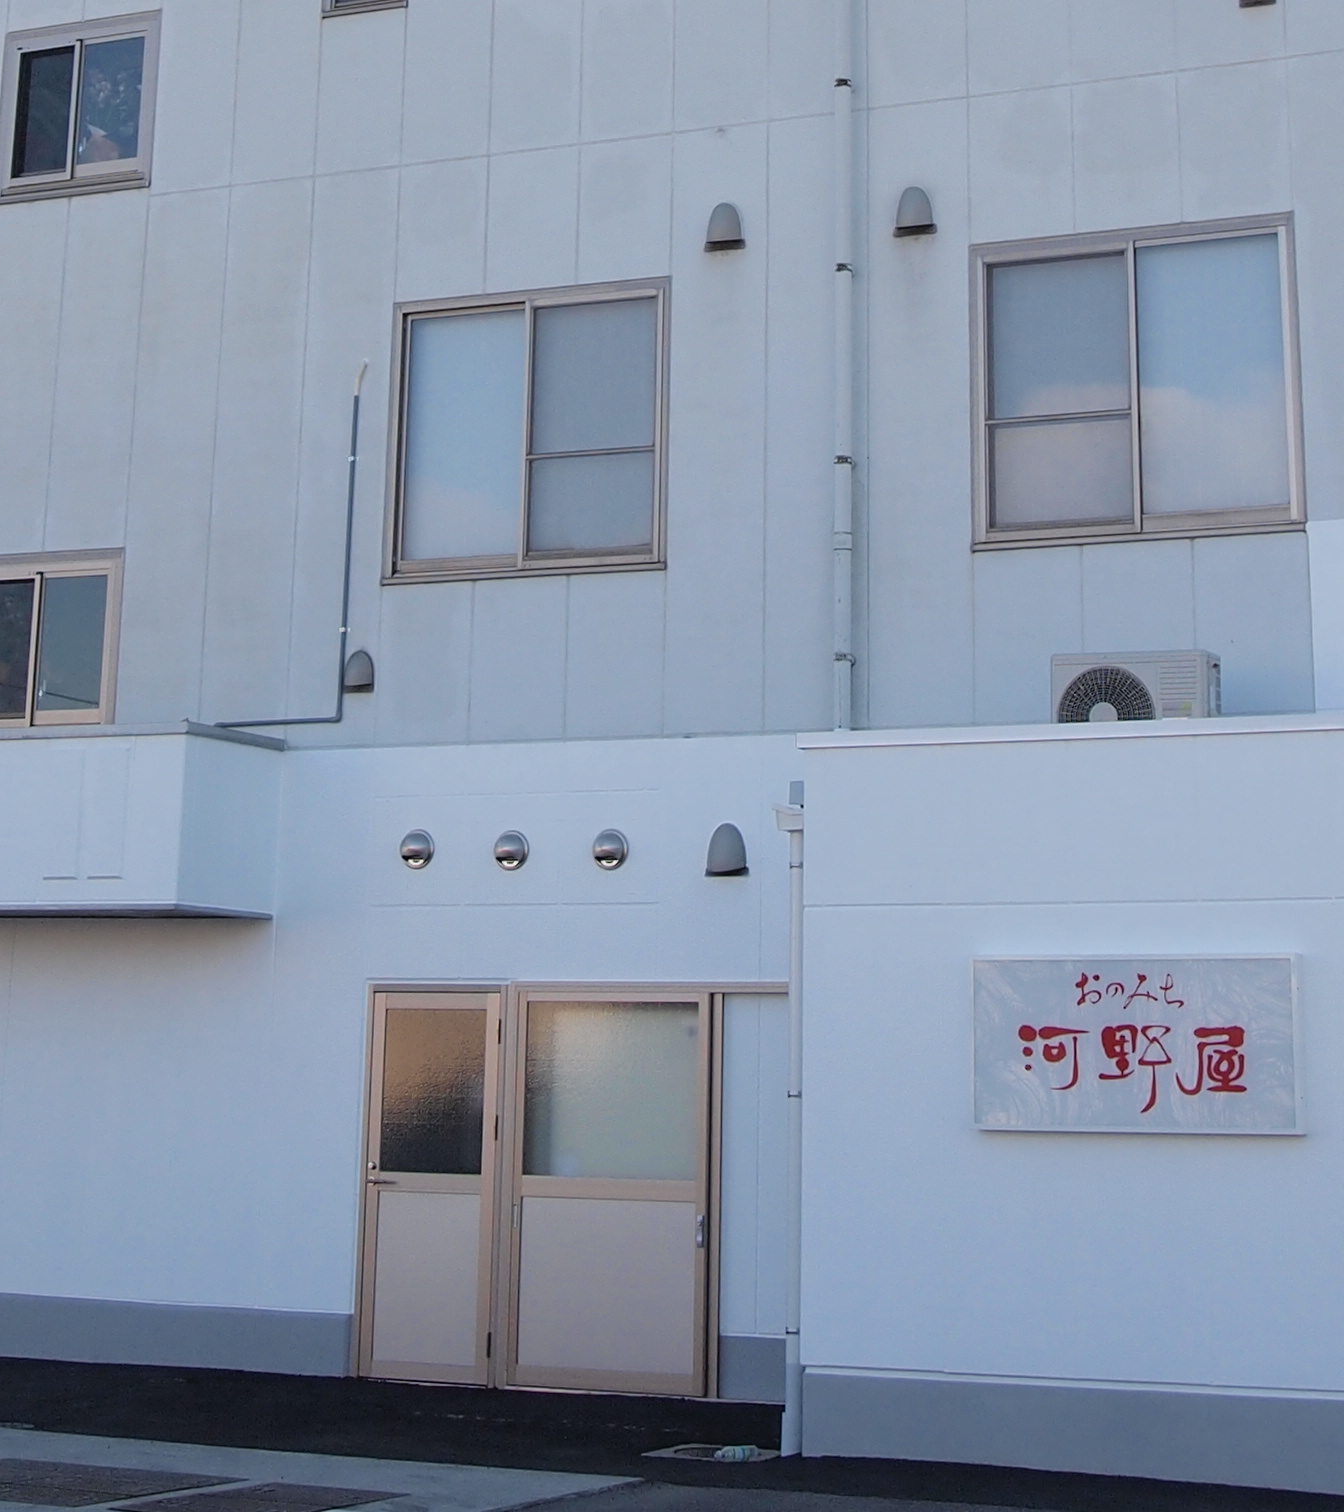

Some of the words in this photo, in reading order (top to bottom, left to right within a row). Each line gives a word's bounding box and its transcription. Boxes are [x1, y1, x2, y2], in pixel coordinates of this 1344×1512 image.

[1075, 972, 1184, 1009] おのみち
[1018, 1024, 1248, 1114] 河野屋
